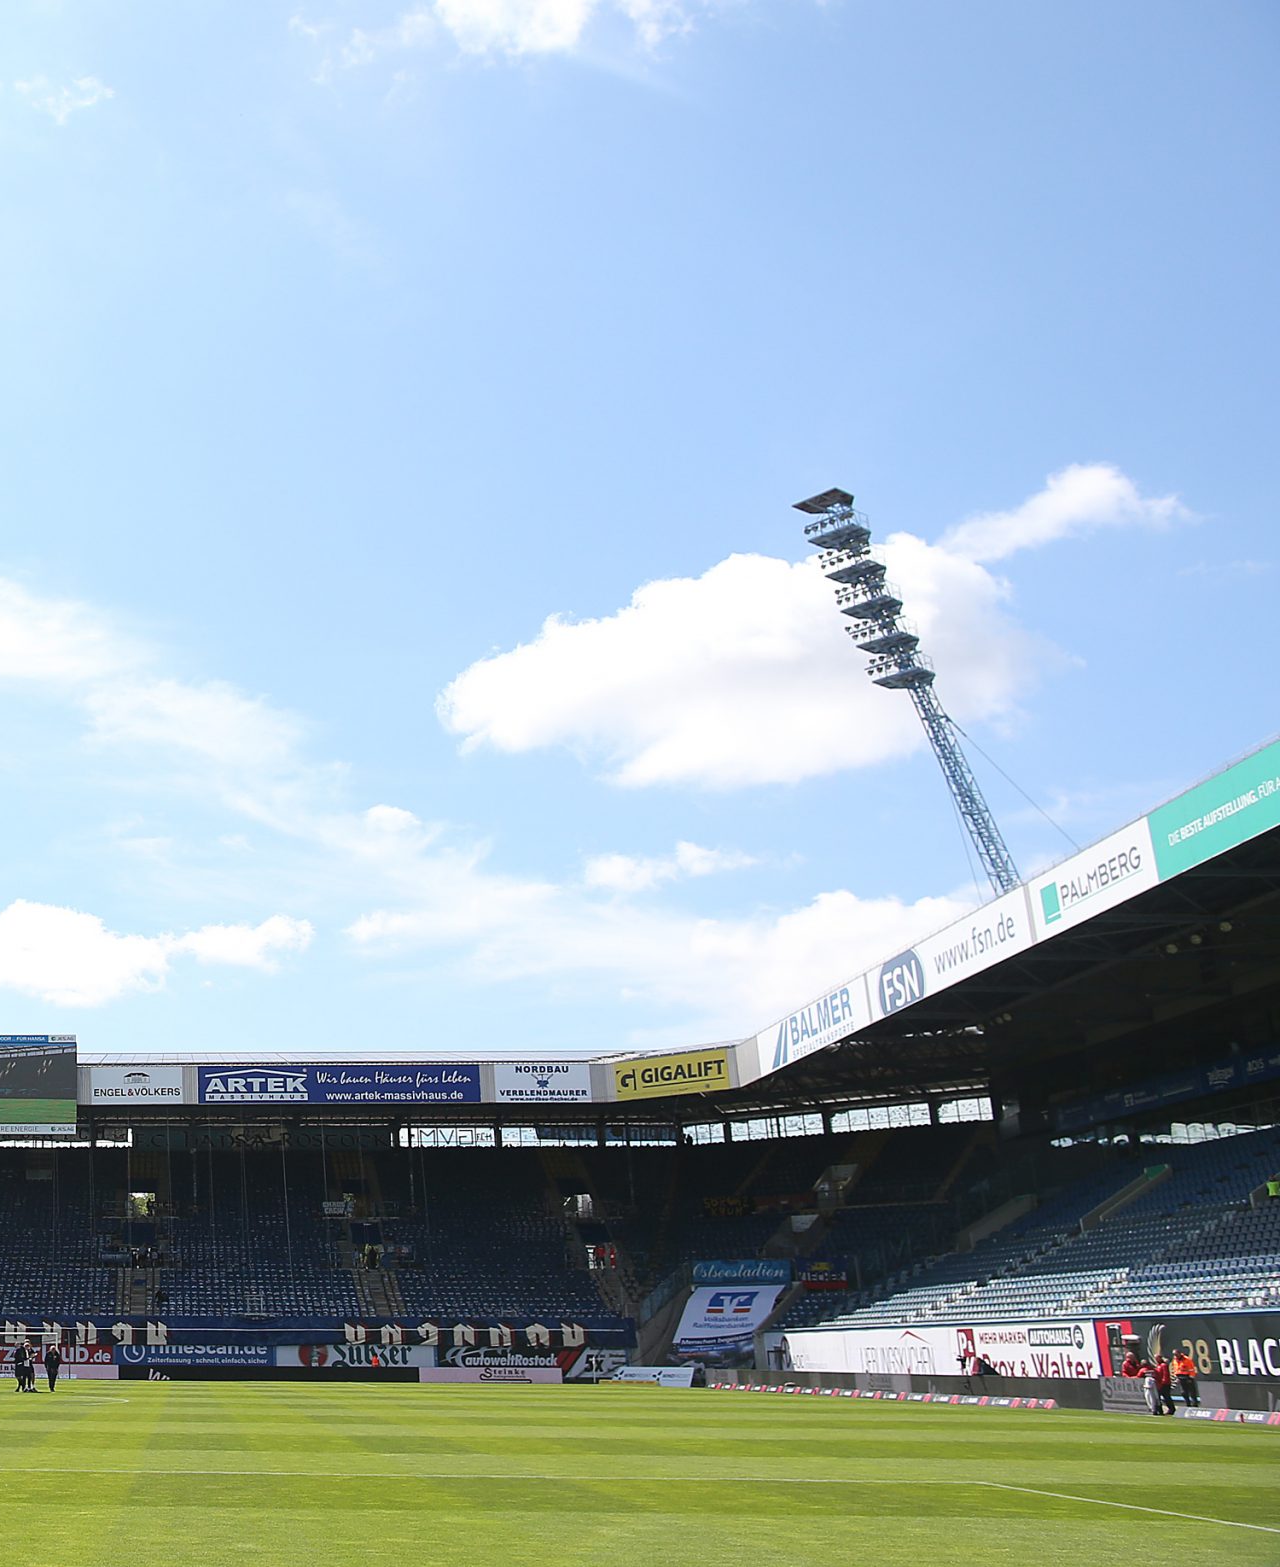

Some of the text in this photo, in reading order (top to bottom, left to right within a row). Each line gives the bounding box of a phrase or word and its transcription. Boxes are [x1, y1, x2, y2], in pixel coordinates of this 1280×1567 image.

[1181, 818, 1204, 840] BESTE
[1258, 779, 1275, 800] FÜR
[1060, 846, 1142, 907] PALMBERG
[933, 913, 1016, 975] www.fsn.de
[882, 959, 921, 1012] FSN
[789, 987, 853, 1046] BALMER
[792, 1021, 855, 1059] SPEZIALTRANSPORTE
[515, 1065, 569, 1074] NORDBAU
[641, 1059, 725, 1084] GIGALIFT
[205, 1077, 308, 1092] ARTEK
[316, 1070, 472, 1087] Wir bauen Häuser fürs Leben
[325, 1091, 464, 1101] www.artek-massivhaus.de
[499, 1089, 588, 1097] VERBLENDMAURER
[692, 1261, 785, 1278] Ostseestadion
[979, 1331, 1027, 1344] MEHR MARKEN
[1029, 1328, 1071, 1345] AUTOHAUS
[147, 1357, 192, 1365] Zeiterfassung
[465, 1352, 558, 1367] autoweltRostock
[1031, 1352, 1094, 1379] Walter
[1182, 1336, 1280, 1378] 28 BLAC
[483, 1367, 526, 1379] Steinke
